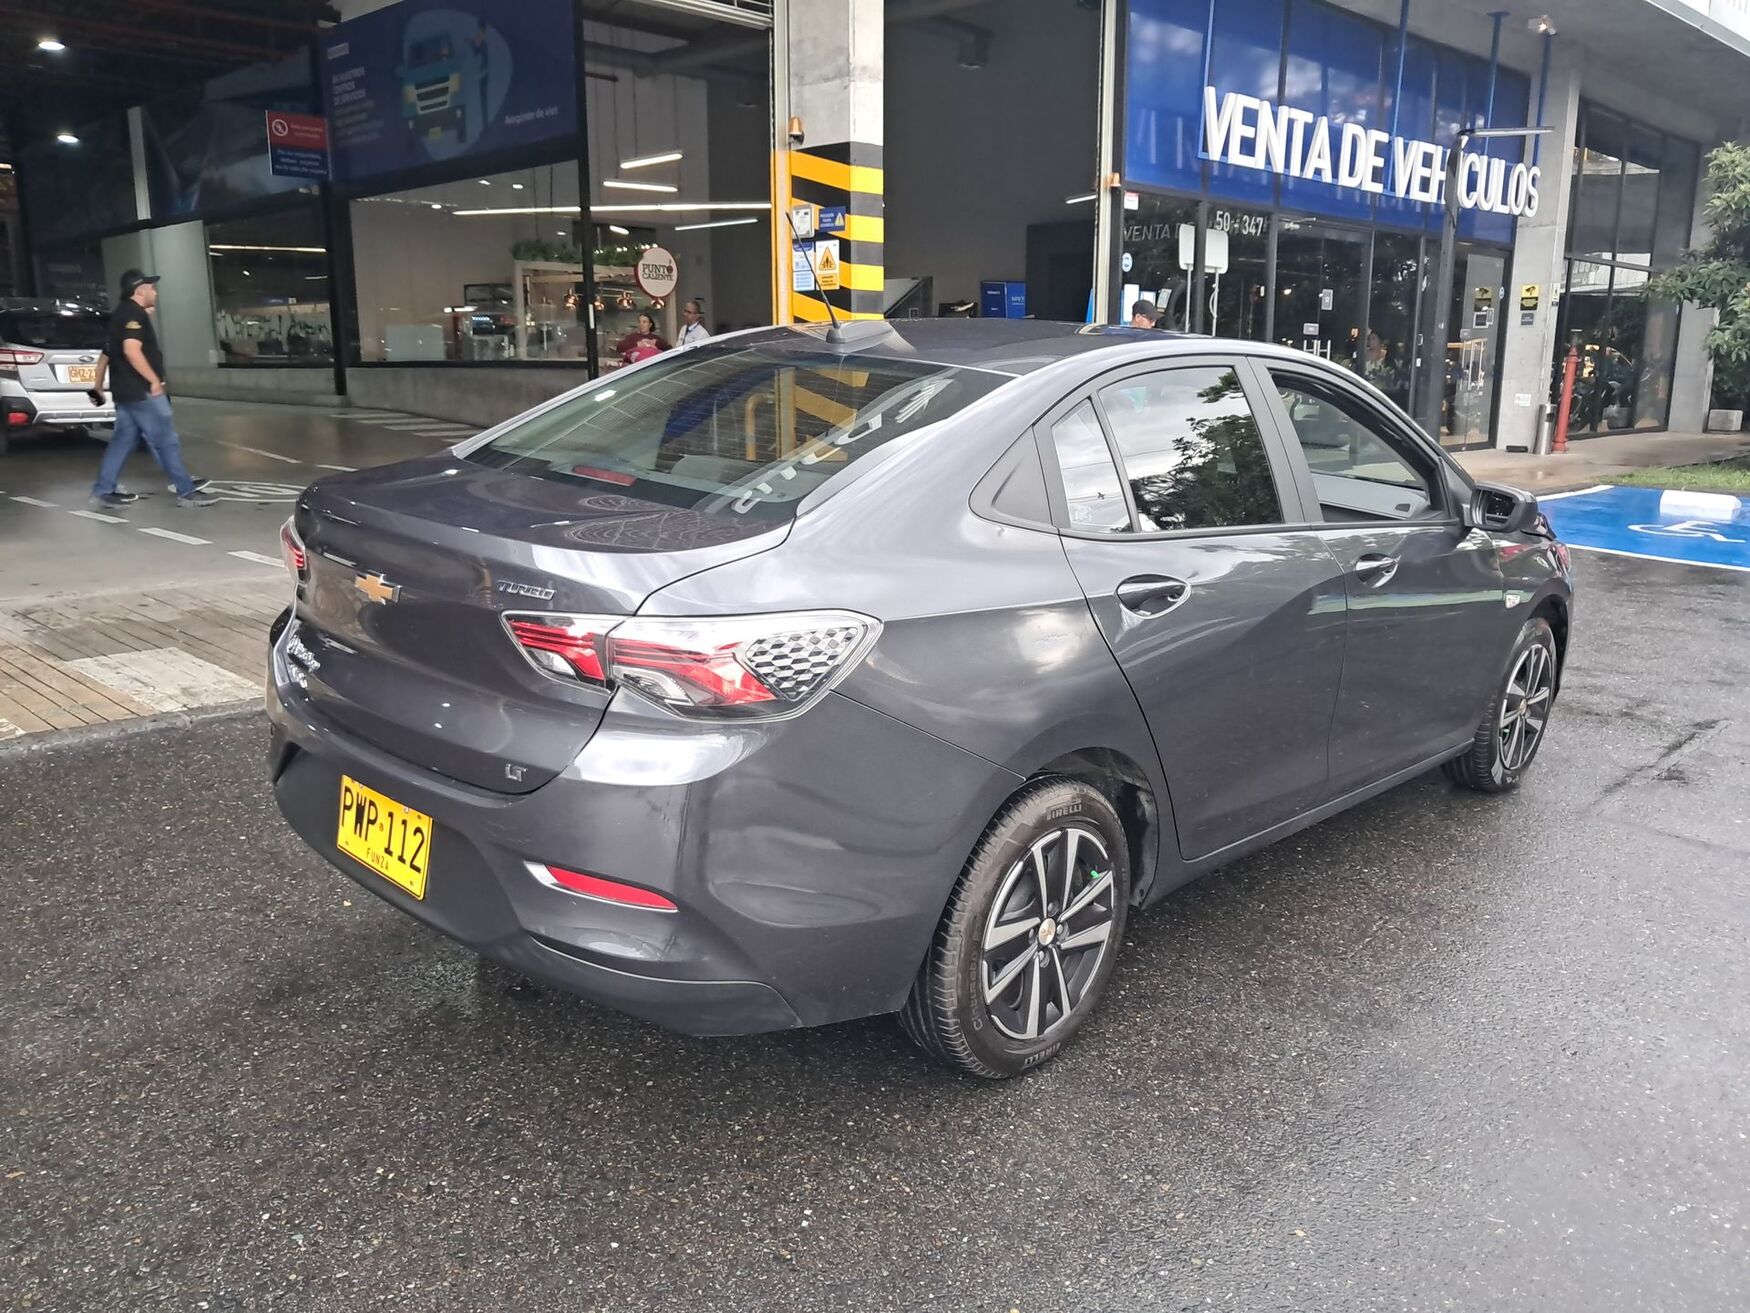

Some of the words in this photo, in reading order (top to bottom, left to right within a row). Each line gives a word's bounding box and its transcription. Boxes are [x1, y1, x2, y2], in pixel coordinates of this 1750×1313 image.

[1203, 86, 1333, 183] VENTA
[1338, 122, 1390, 194] DE
[1123, 223, 1171, 242] VENTA
[498, 579, 556, 601] TURBO
[505, 763, 527, 782] LT
[367, 847, 389, 871] FUNZA
